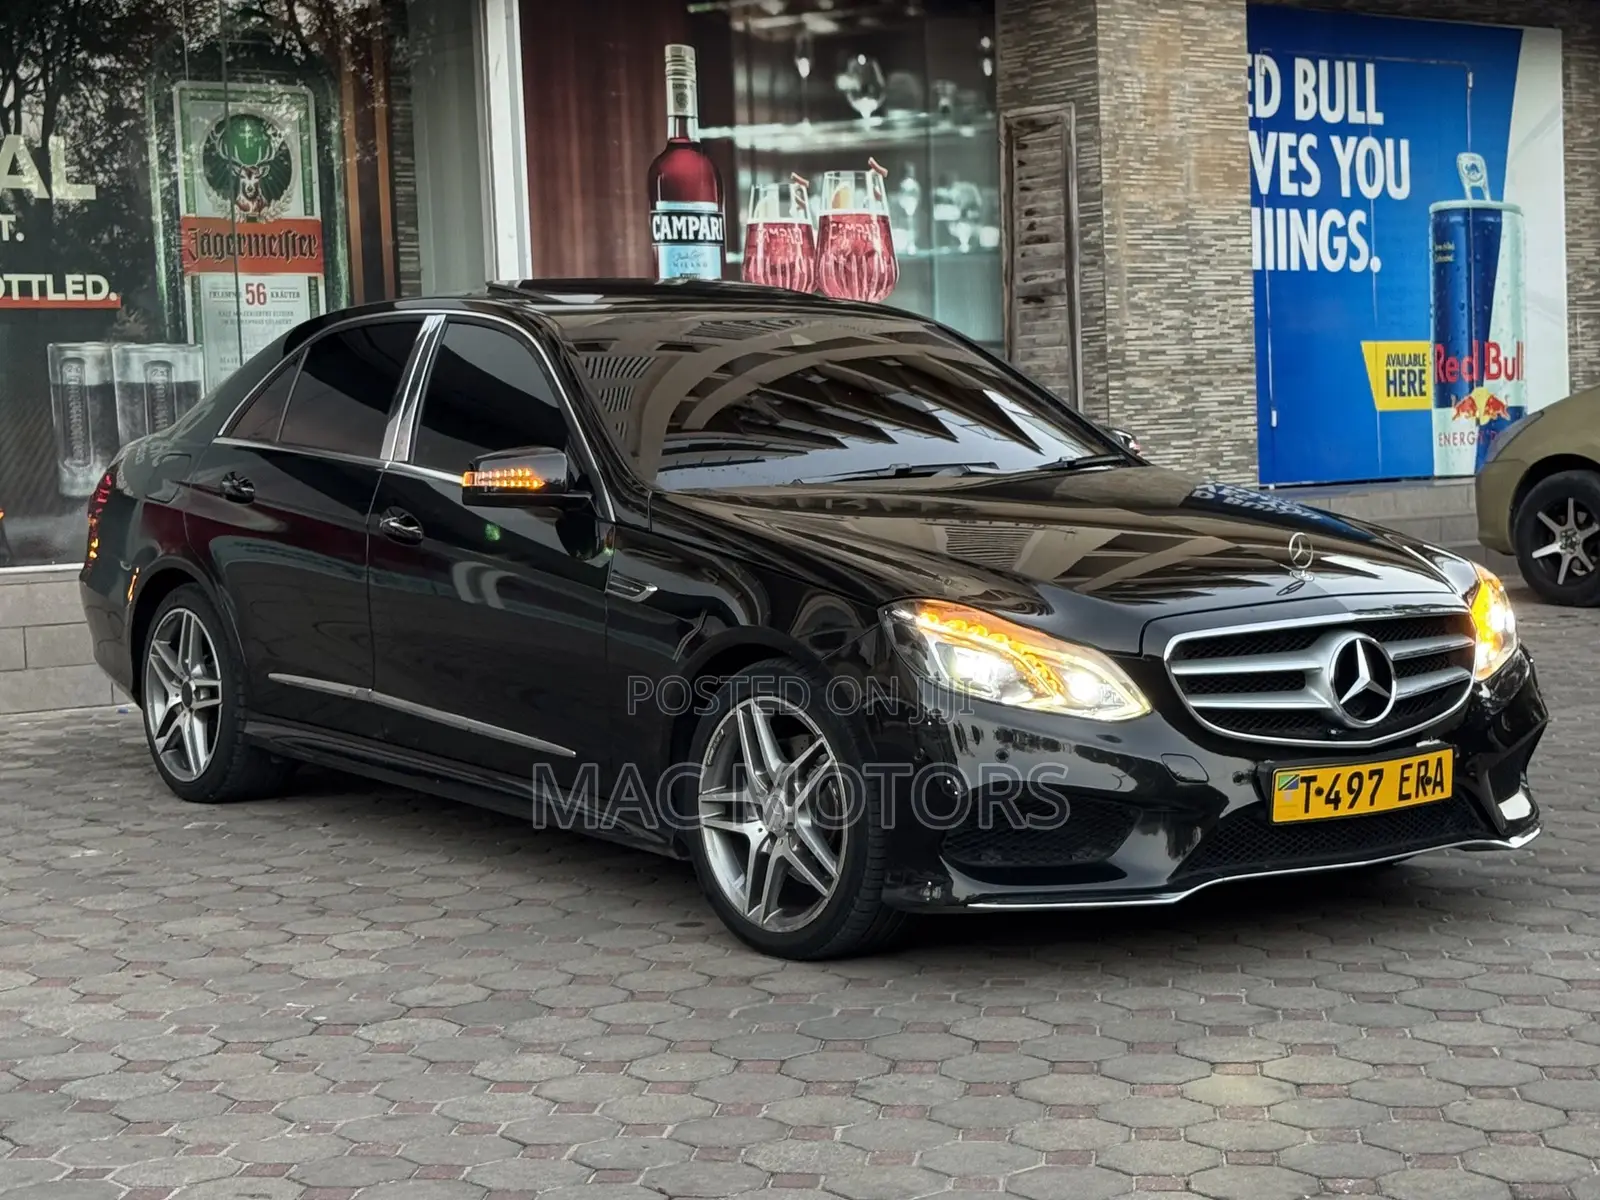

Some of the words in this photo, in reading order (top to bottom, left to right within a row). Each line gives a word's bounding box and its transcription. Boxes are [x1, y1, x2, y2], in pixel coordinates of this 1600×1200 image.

[1295, 57, 1384, 125] BULL
[1329, 135, 1410, 200] YOU
[652, 215, 723, 241] CAMPARI
[0, 273, 118, 301] TTLED.
[245, 283, 267, 306] 56
[1386, 353, 1427, 367] AVAILABLE
[1434, 339, 1479, 384] Red
[1484, 341, 1523, 382] Bull
[1386, 369, 1427, 397] HERE
[1397, 756, 1445, 802] ERA
